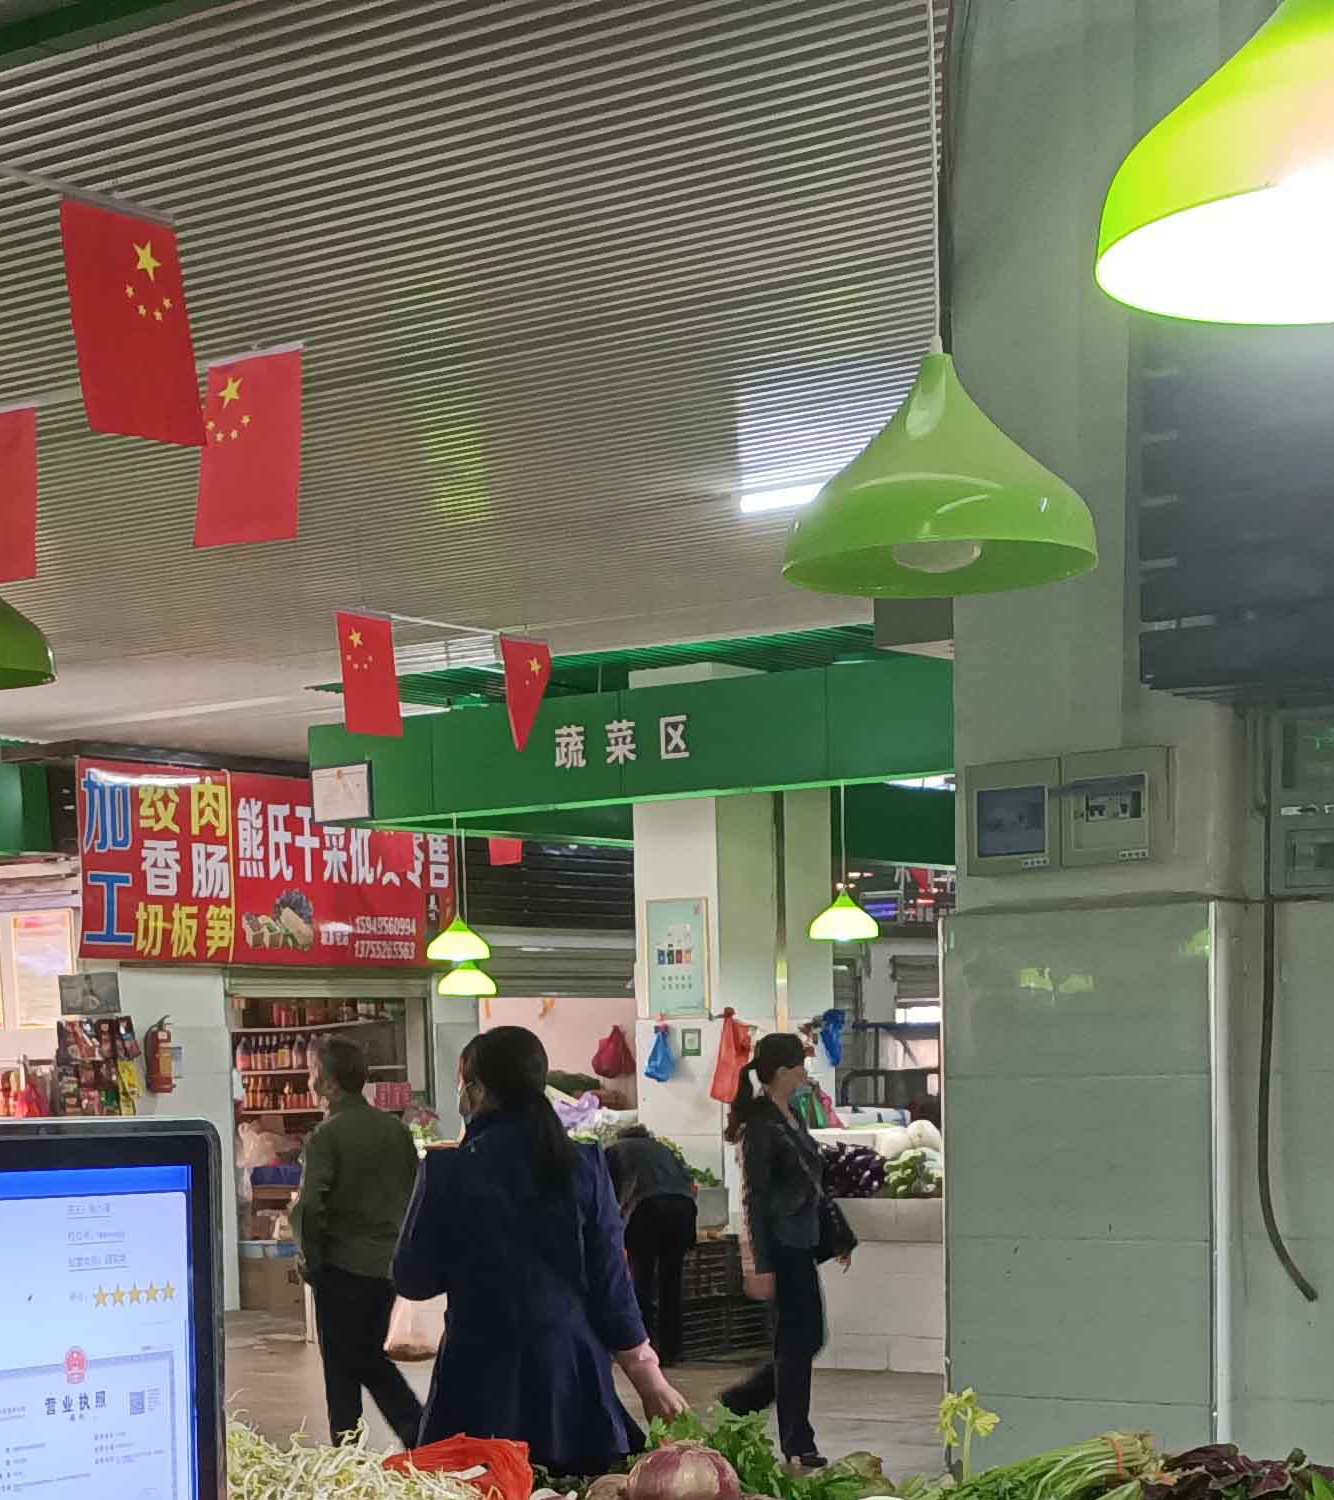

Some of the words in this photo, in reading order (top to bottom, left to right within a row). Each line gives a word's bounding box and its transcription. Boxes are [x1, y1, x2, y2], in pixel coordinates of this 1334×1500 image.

[554, 714, 690, 769] 蔬菜区
[138, 776, 227, 837] 绞肉
[81, 768, 135, 945] 加工
[141, 839, 230, 898] 香肠
[45, 1390, 107, 1416] 营业执照
